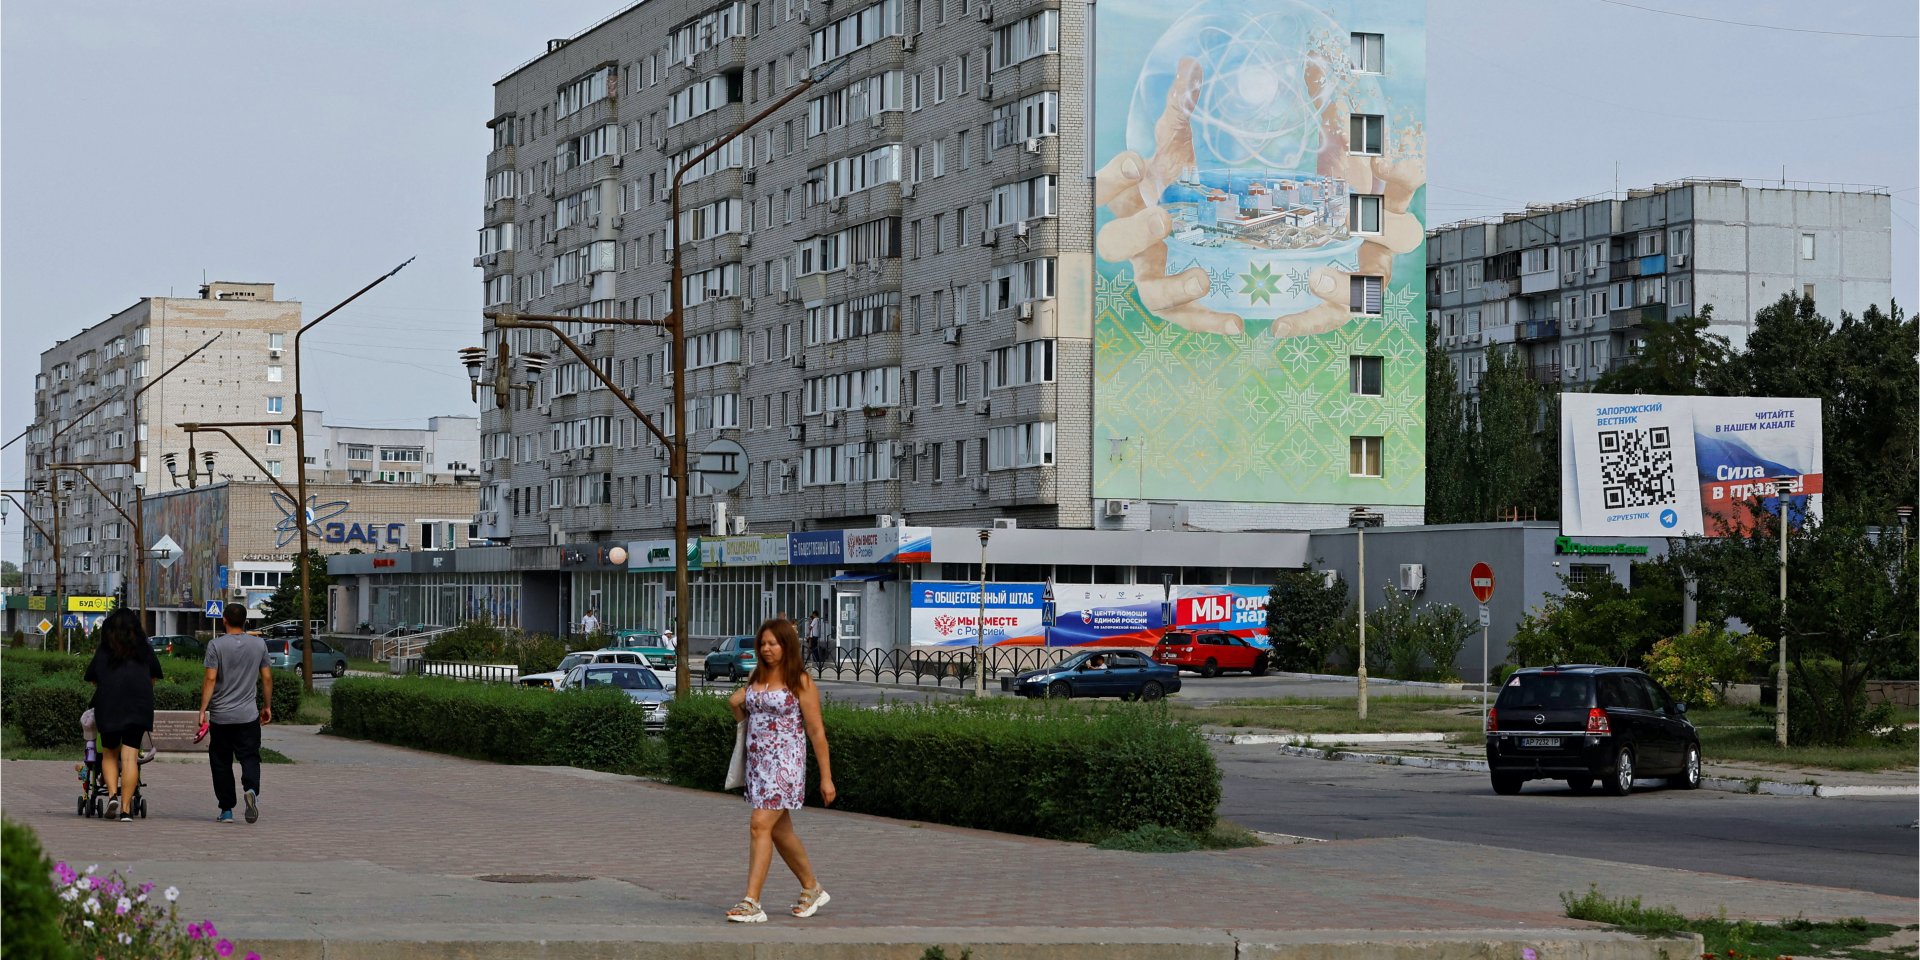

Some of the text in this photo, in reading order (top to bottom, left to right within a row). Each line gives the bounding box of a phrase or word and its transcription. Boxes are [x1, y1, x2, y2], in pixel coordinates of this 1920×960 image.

[1596, 402, 1662, 416] ЗАПОРОЖСКИЙ
[1755, 409, 1795, 420] ЧИТАЙТЕ
[1597, 416, 1638, 426] ВЕСТНИК
[1715, 420, 1795, 433] В НАШЕМ КАНАЛЕ
[1716, 465, 1765, 480] Сила
[1712, 486, 1724, 499] в
[1606, 512, 1650, 522] @ZPVESTNIK
[1009, 591, 1034, 605] ШТАБ
[79, 600, 94, 608] БУД
[1191, 596, 1231, 622] МЫ
[957, 617, 976, 626] МЫ
[957, 626, 1005, 636] с Росией
[1535, 738, 1549, 746] 7232
